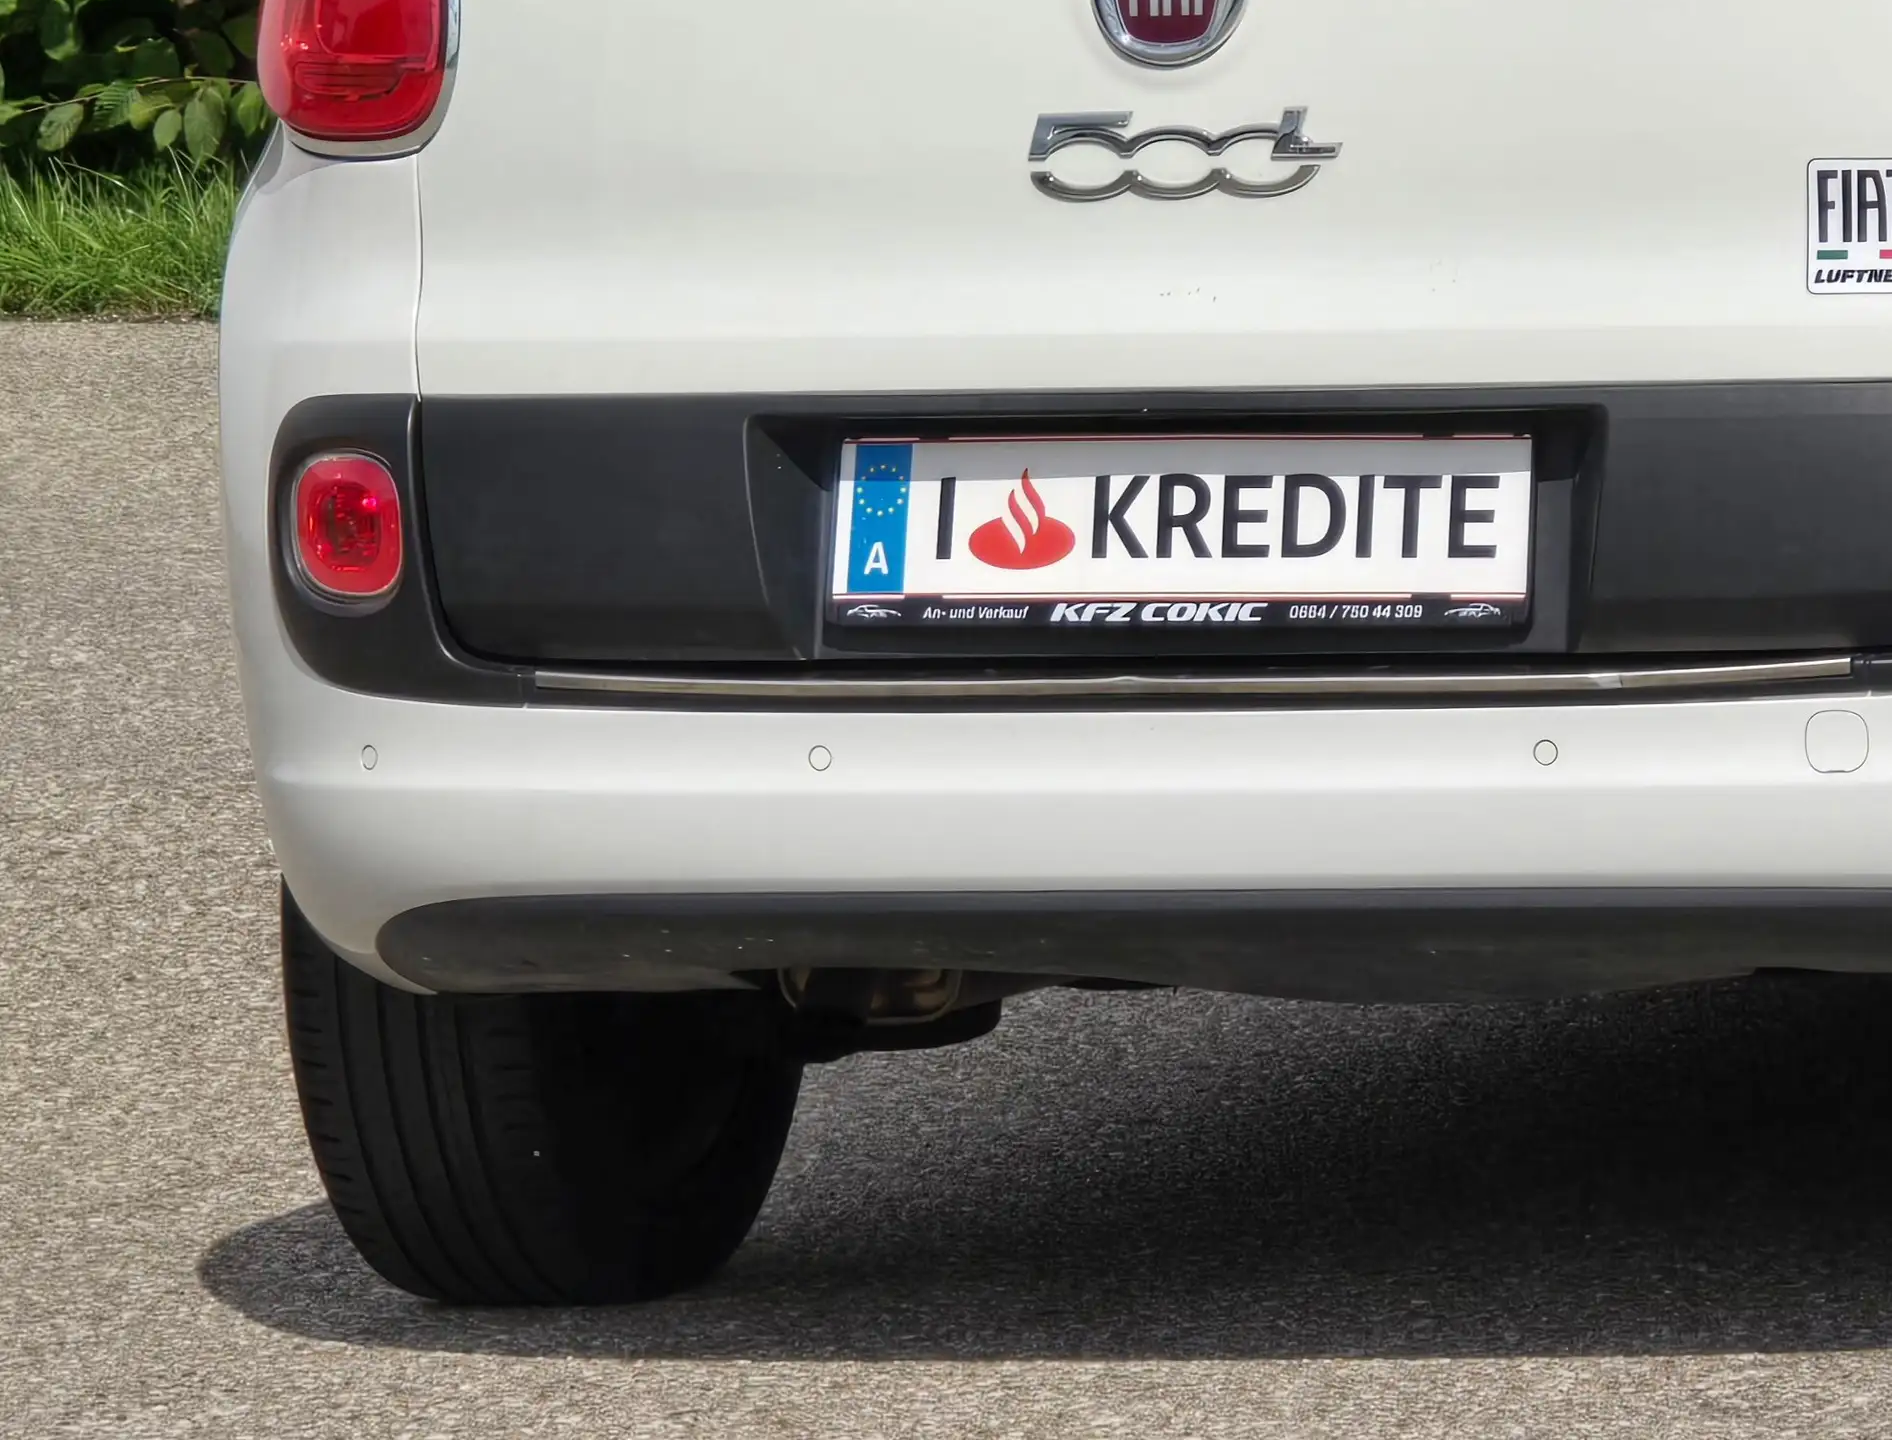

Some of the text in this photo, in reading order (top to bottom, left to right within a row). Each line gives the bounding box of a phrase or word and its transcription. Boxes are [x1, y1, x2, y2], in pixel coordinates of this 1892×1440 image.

[1028, 105, 1343, 203] 500L
[935, 473, 1503, 560] I KREDITE
[862, 541, 889, 576] A
[922, 606, 947, 619] An-
[949, 605, 975, 619] und
[978, 605, 1030, 619] Verkauf
[1051, 602, 1137, 623] KFZ
[1140, 602, 1268, 622] COKIC
[1372, 605, 1394, 619] 44
